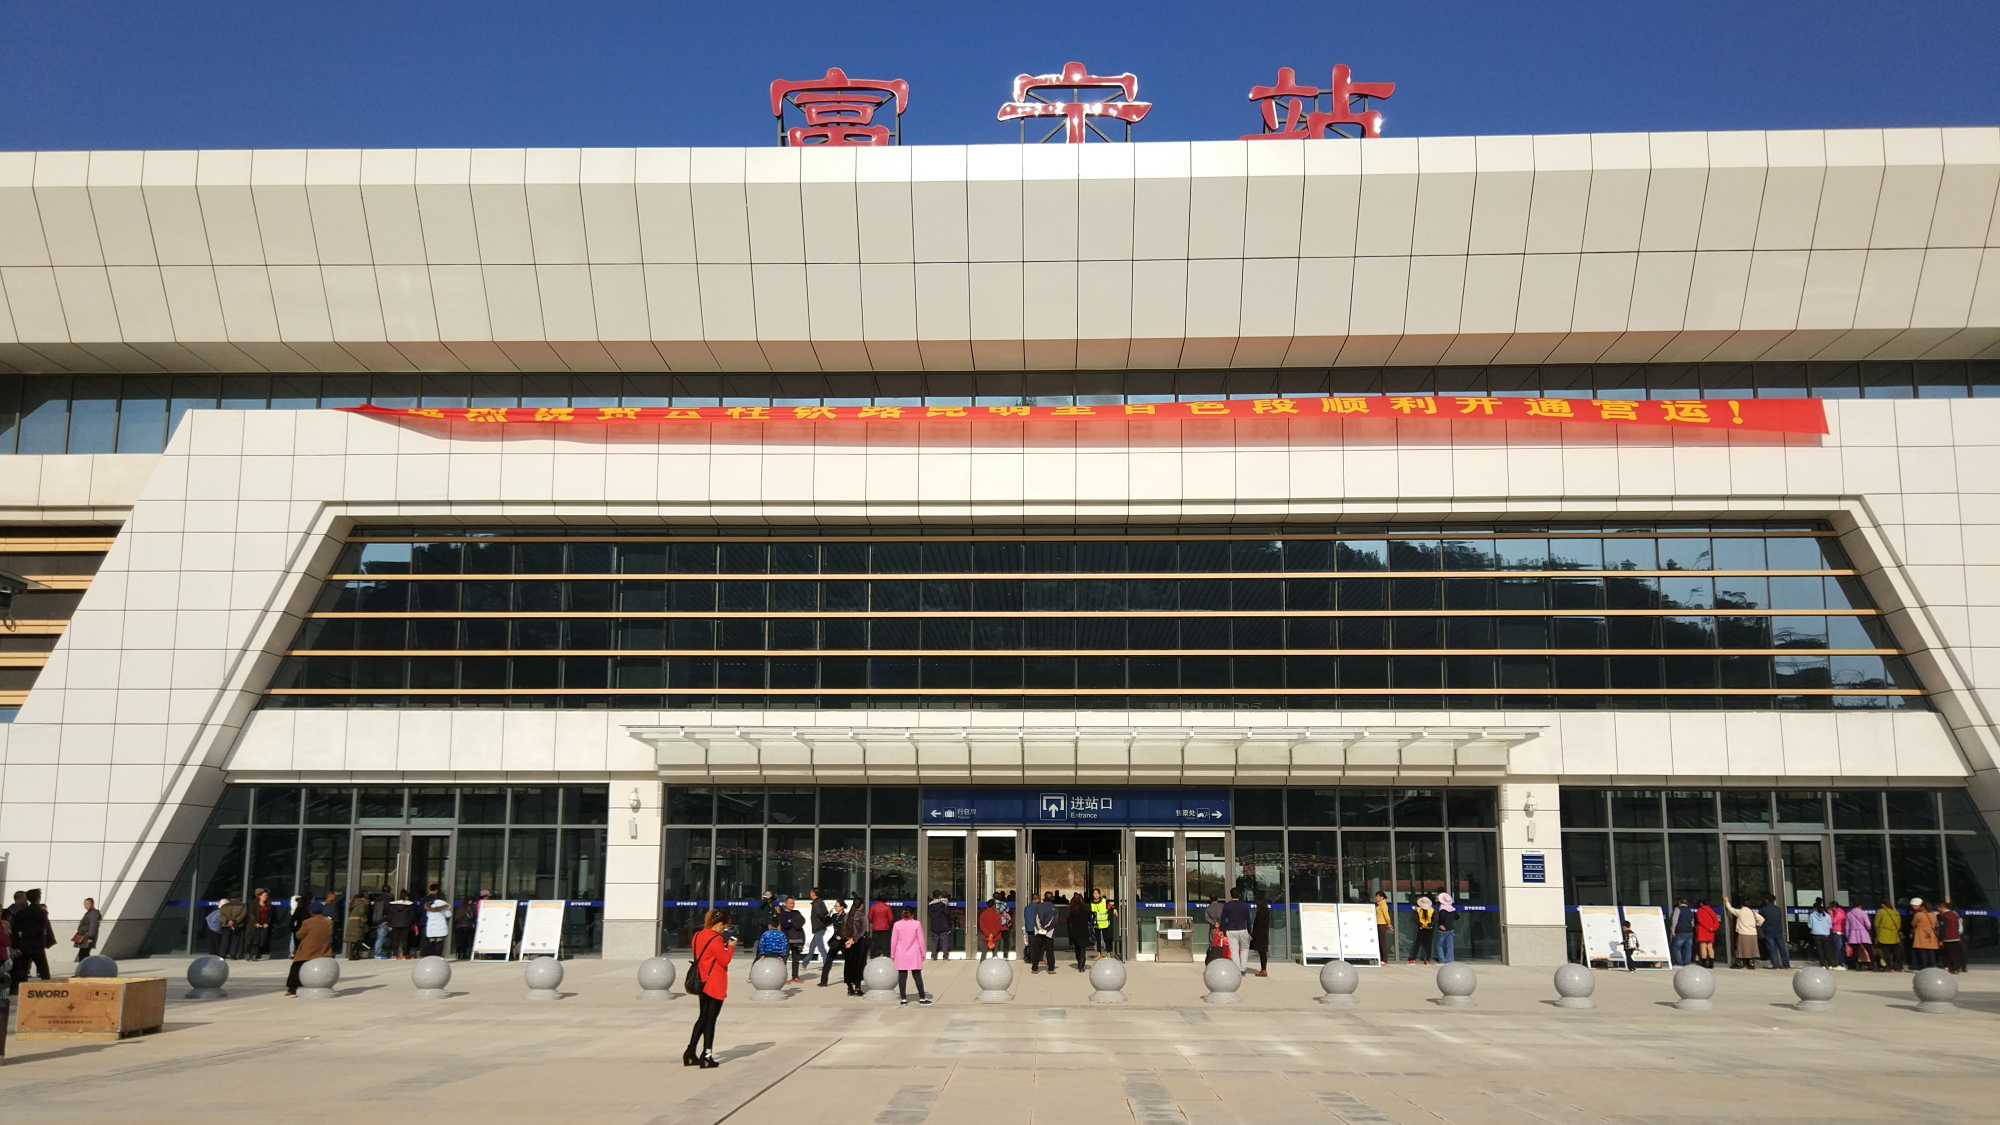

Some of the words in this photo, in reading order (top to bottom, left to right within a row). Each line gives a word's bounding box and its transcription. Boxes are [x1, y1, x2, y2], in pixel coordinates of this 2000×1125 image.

[1070, 796, 1113, 811] 进站口
[1175, 809, 1196, 817] 售票处
[27, 989, 70, 998] SWORD
